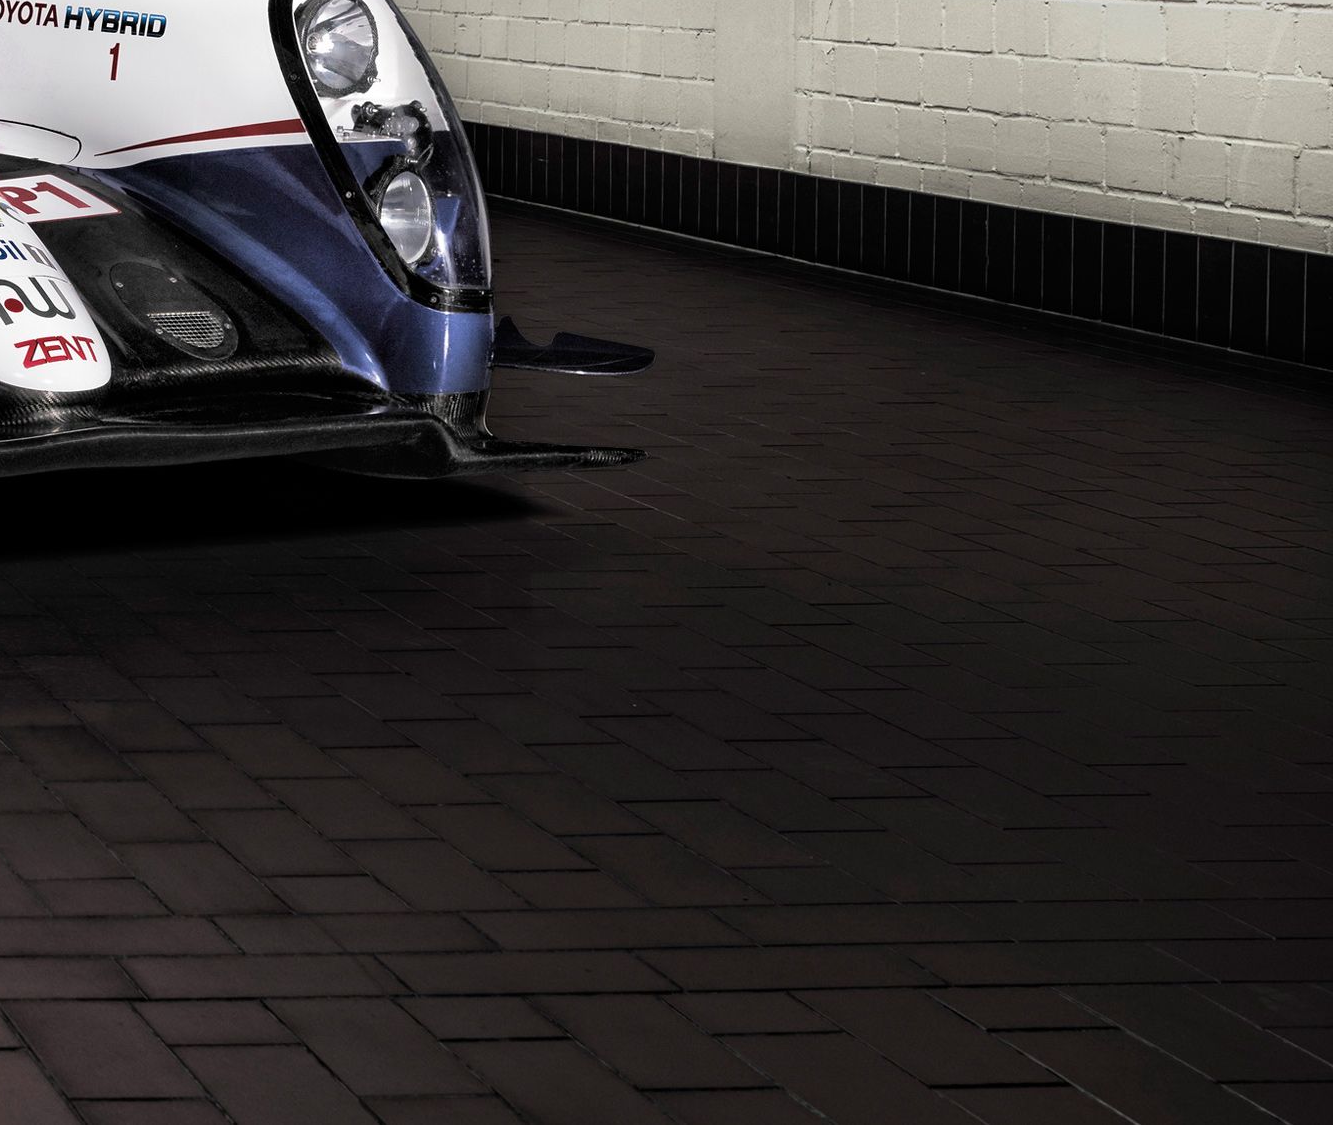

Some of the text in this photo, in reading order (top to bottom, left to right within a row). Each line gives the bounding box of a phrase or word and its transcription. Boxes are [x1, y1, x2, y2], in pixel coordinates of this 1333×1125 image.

[63, 5, 168, 38] HYBRID
[109, 42, 120, 81] 1
[14, 335, 97, 369] ZENT
